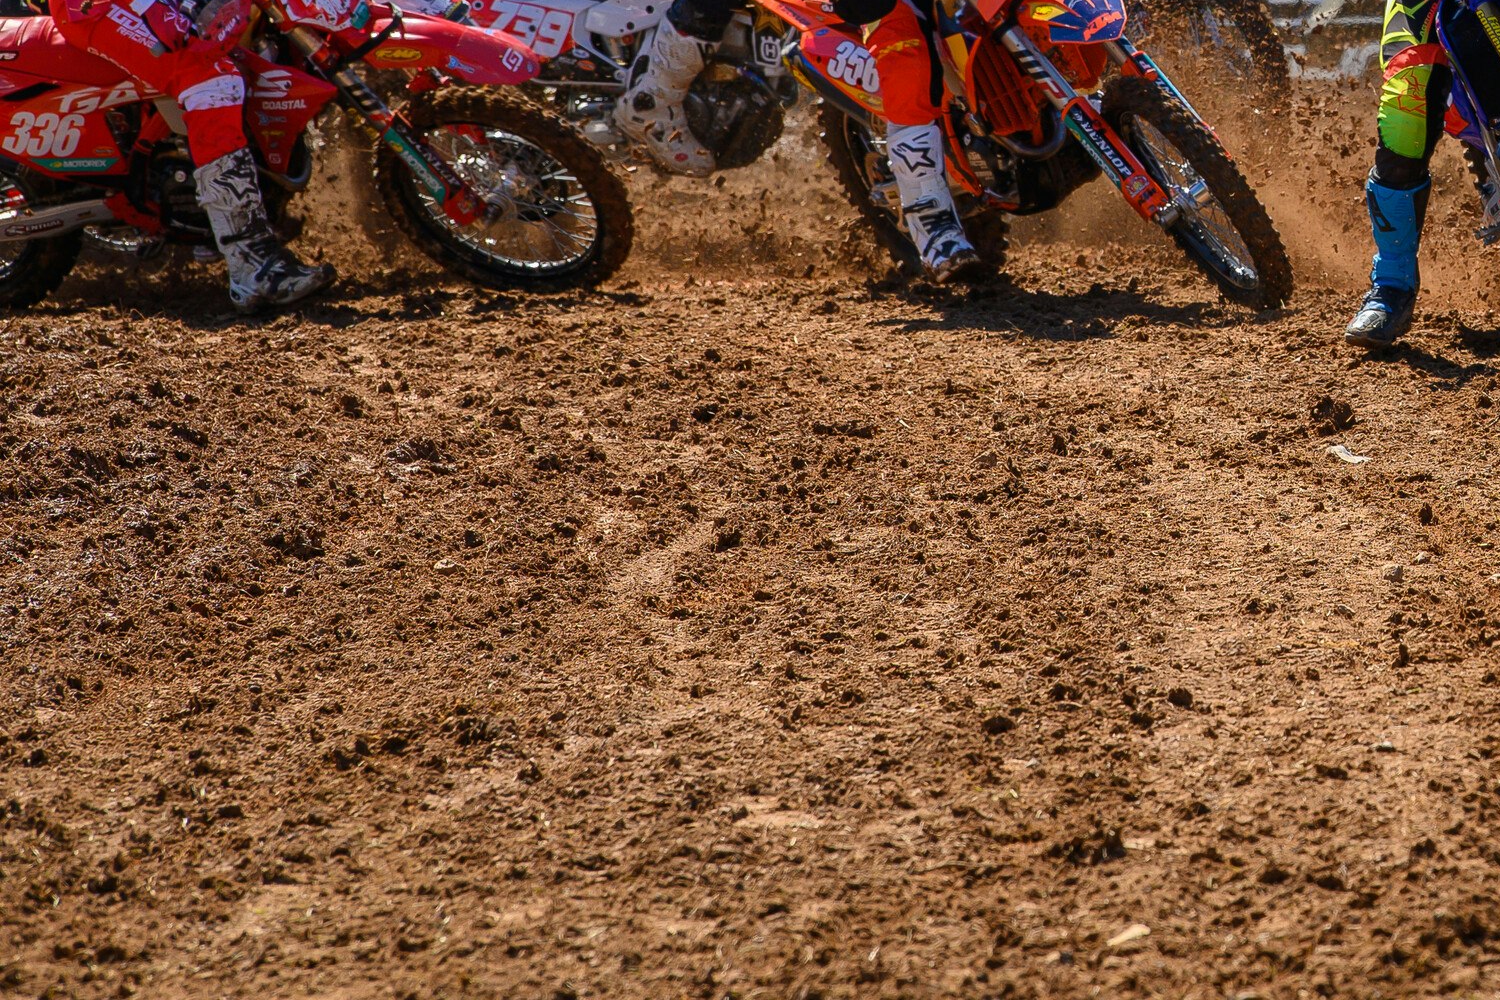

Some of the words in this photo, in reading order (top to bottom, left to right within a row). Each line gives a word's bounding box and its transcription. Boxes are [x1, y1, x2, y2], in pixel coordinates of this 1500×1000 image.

[116, 26, 157, 50] RACING
[1083, 11, 1122, 42] KTM
[827, 40, 880, 94] 356
[262, 99, 307, 110] COASTAL
[1, 110, 85, 157] 336
[63, 159, 107, 169] MOTOREX
